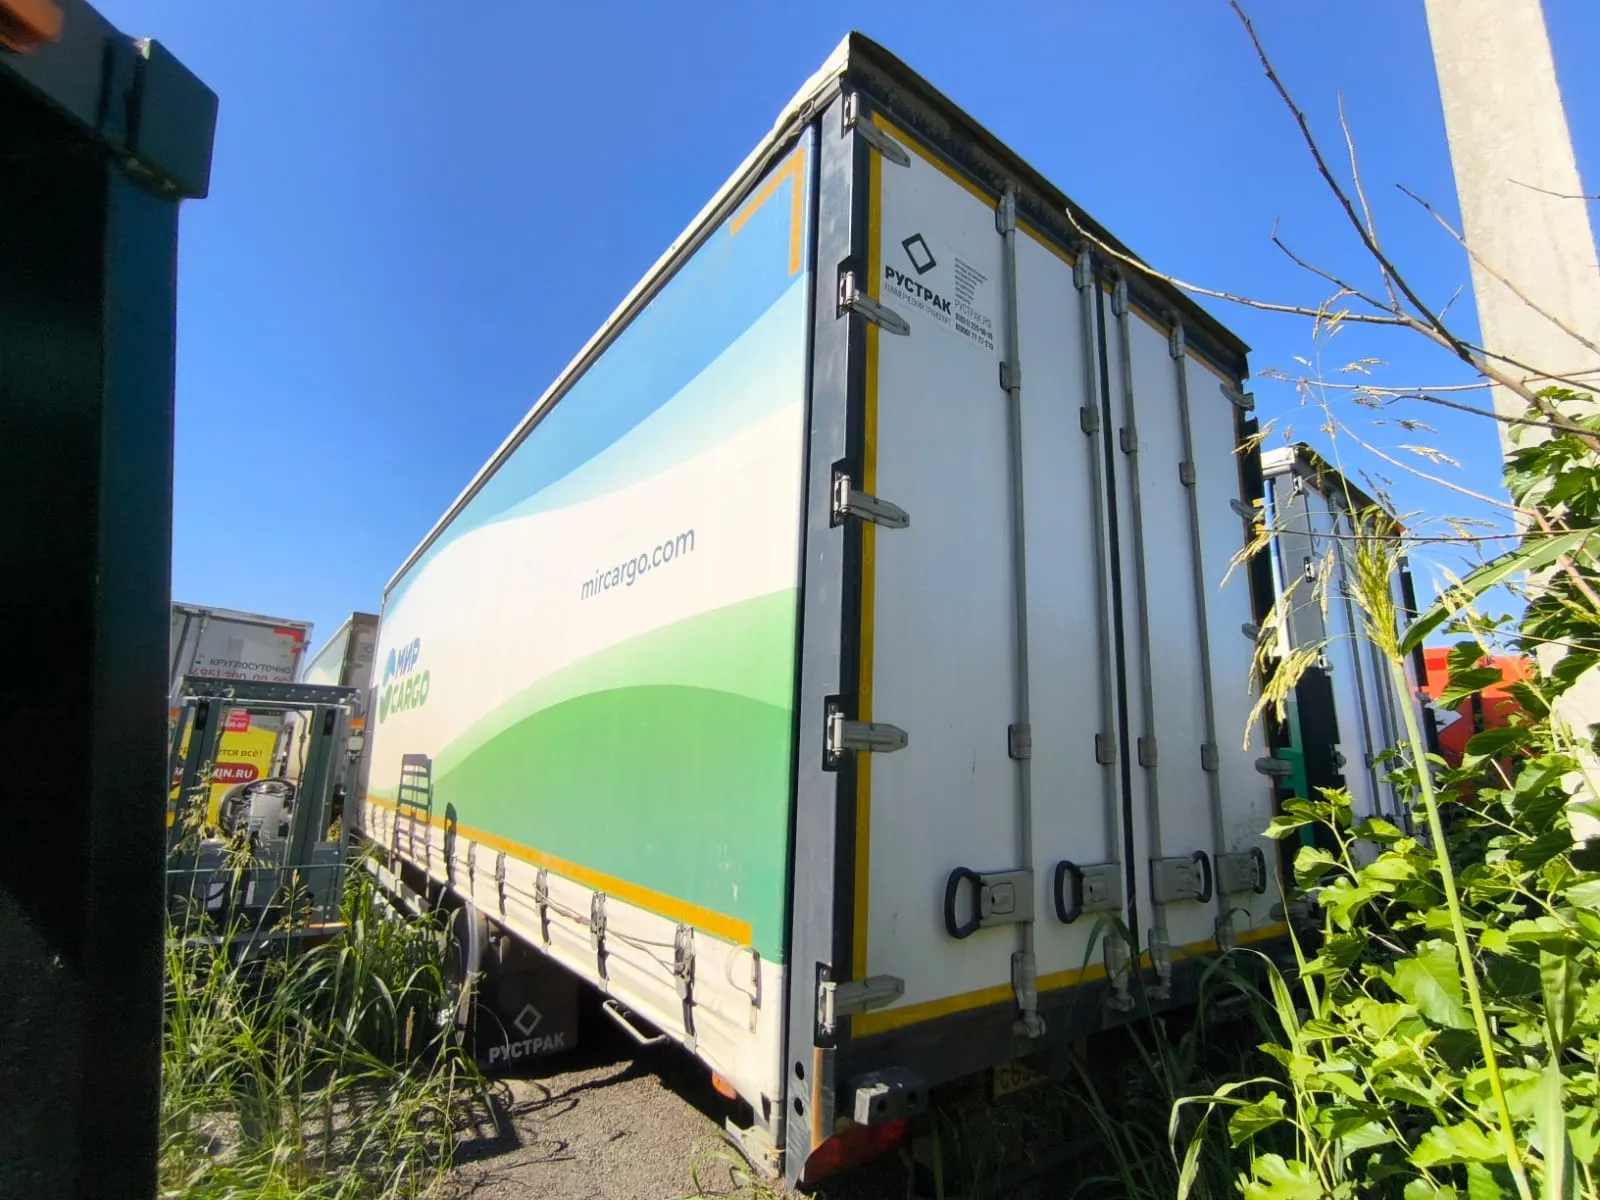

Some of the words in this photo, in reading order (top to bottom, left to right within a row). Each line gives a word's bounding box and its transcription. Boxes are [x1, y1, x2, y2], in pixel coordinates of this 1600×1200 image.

[885, 265, 952, 315] РУСТРАК
[581, 529, 695, 600] mircargo.com
[209, 658, 291, 674] КРУГЛОСУТОЧНО
[395, 637, 420, 678] МИР
[391, 669, 430, 713] CARGO
[489, 1032, 564, 1064] РУСТРАК
